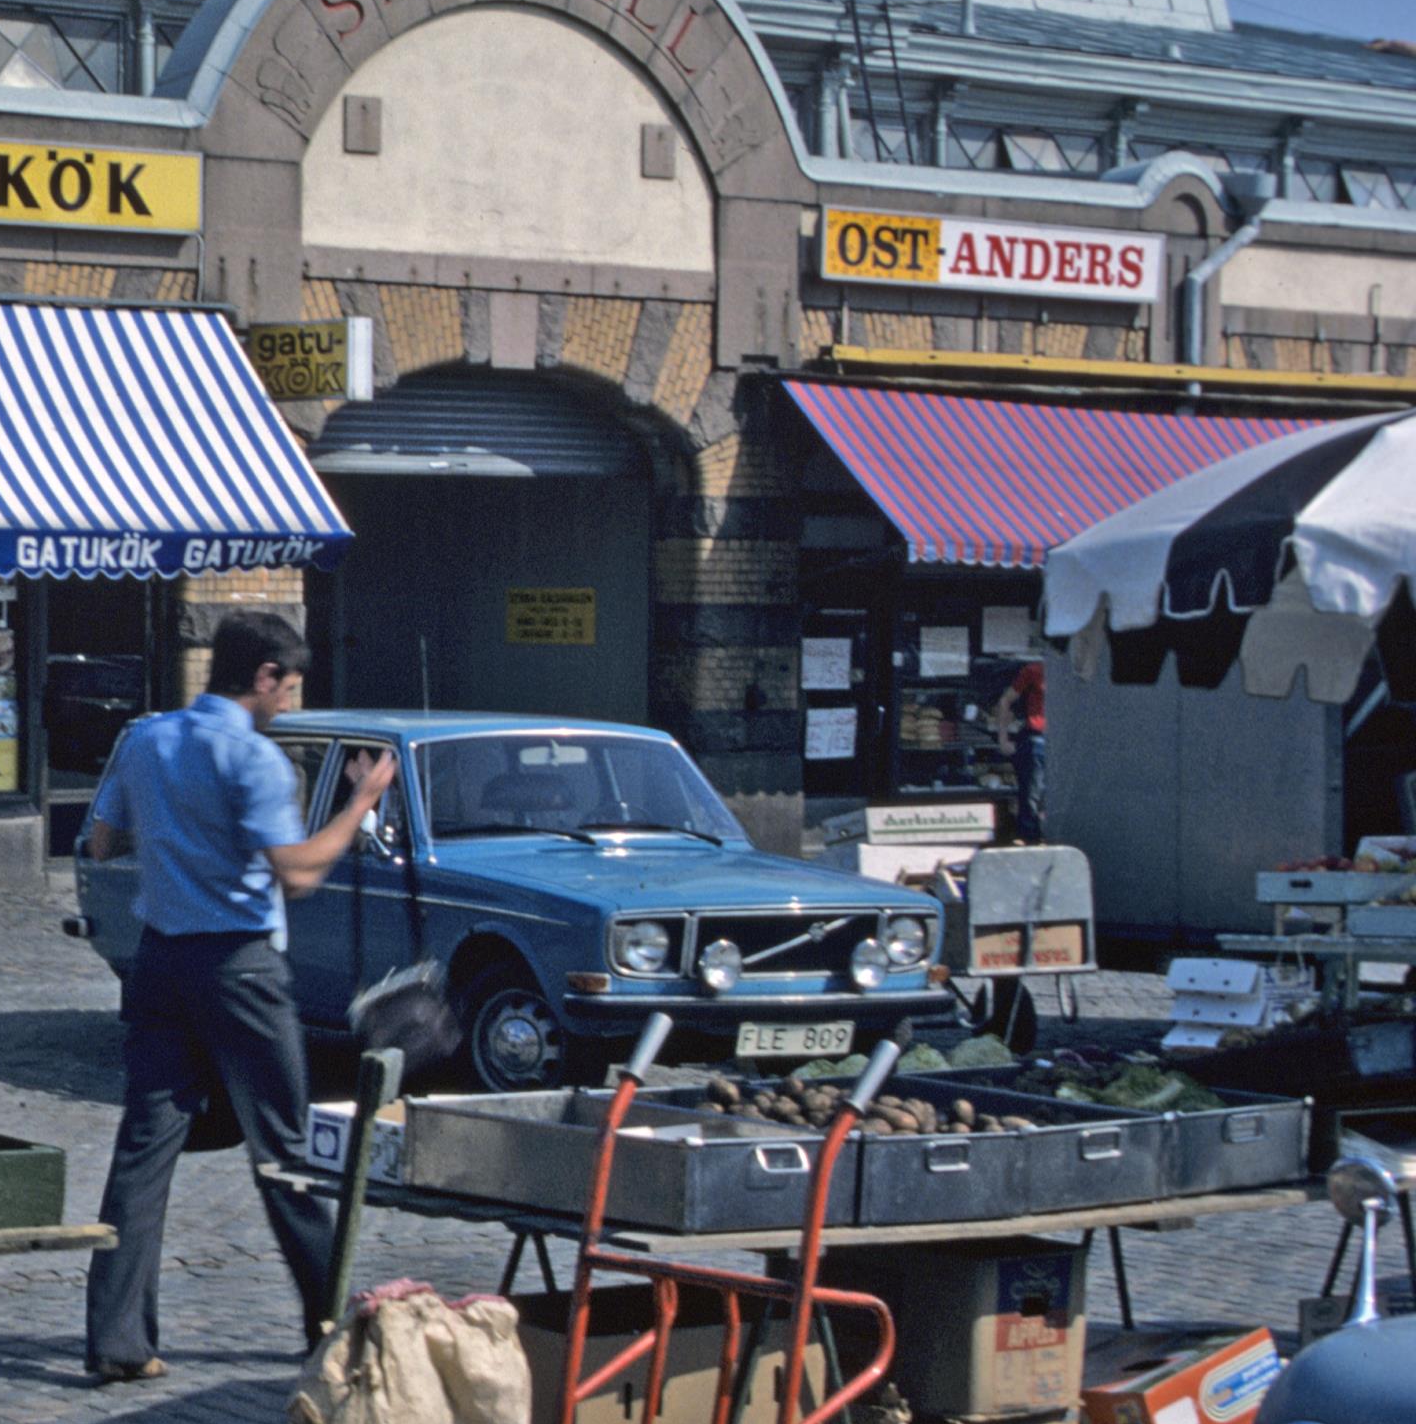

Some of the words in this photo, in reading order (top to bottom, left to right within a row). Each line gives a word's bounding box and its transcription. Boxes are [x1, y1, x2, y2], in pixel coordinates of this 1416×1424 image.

[259, 357, 344, 395] KÖK
[16, 532, 163, 570] GATUKÖK
[184, 533, 326, 570] GATUKÖK
[741, 1027, 787, 1051] FLE
[803, 1026, 848, 1051] 809
